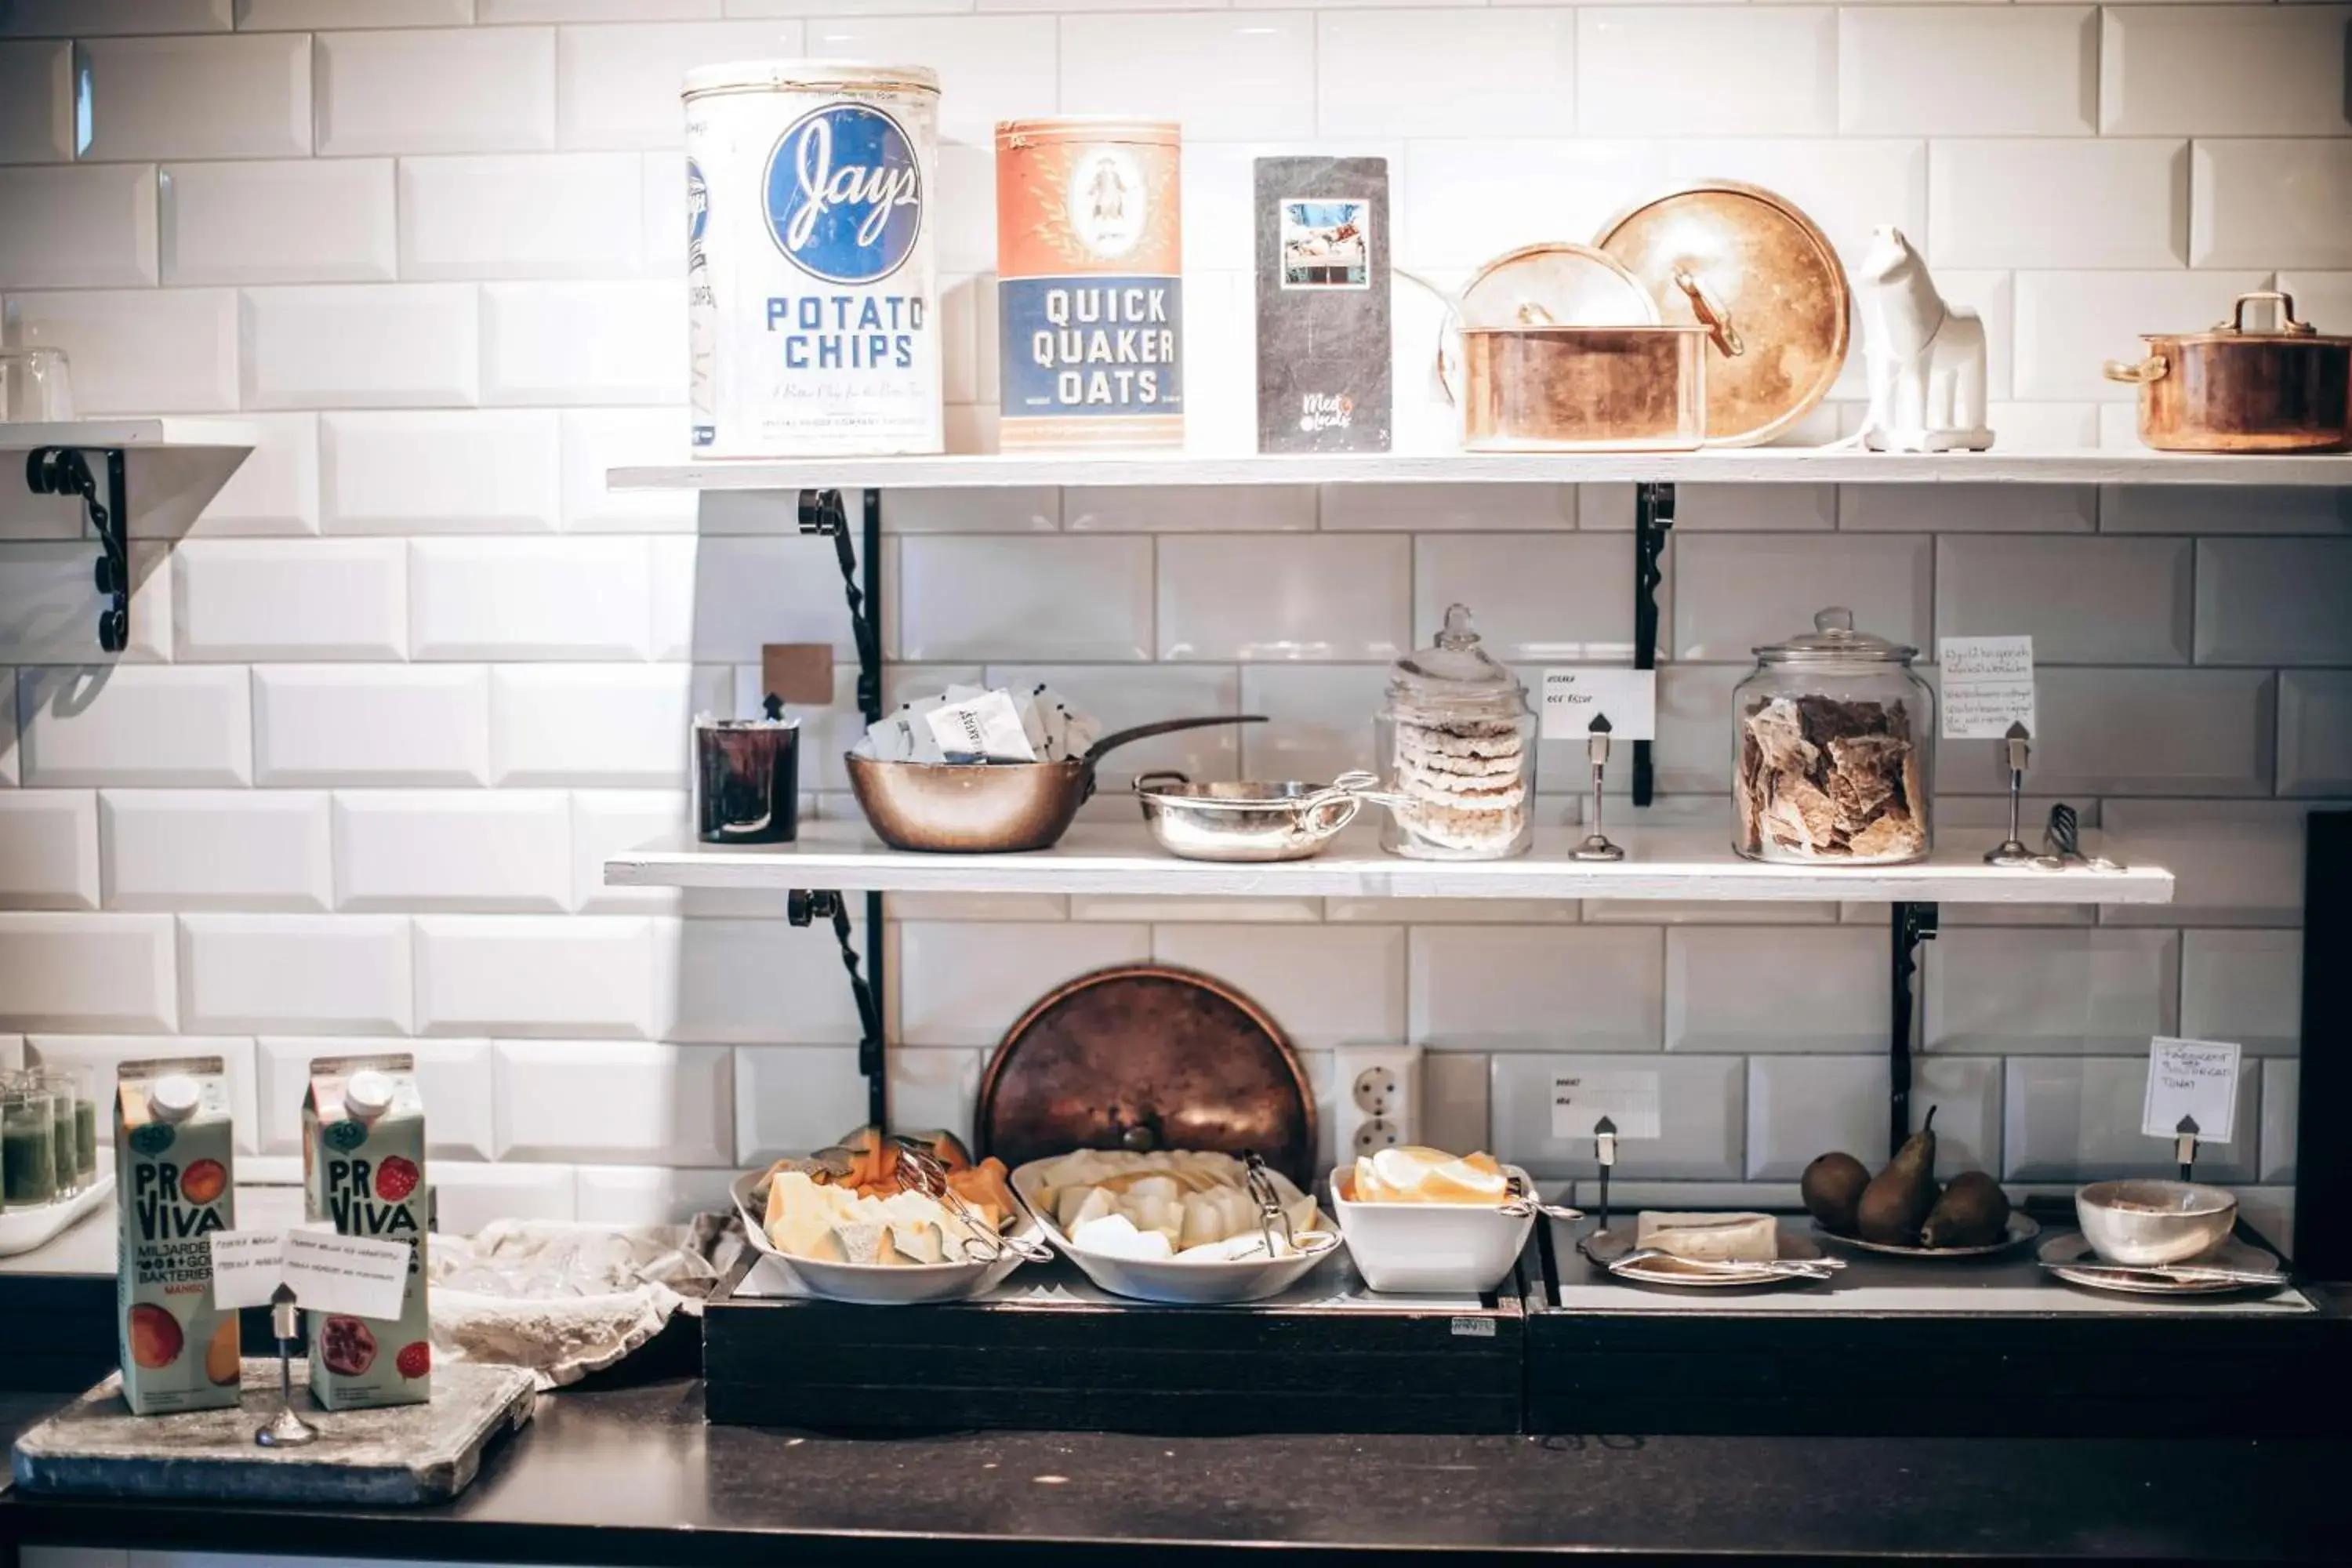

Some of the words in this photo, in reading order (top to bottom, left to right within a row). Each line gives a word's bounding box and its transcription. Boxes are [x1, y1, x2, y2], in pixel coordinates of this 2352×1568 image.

[787, 117, 919, 252] Jays
[767, 296, 924, 331] POTATO
[1045, 288, 1167, 327] QUICK
[786, 335, 912, 368] CHIPS
[1032, 328, 1174, 368] QUAKER
[1058, 369, 1158, 405] OATS
[136, 1189, 226, 1241] VIVA
[330, 1185, 419, 1236] VIVA
[138, 1241, 211, 1257] MILJARDE
[165, 1283, 205, 1294] MANGO
